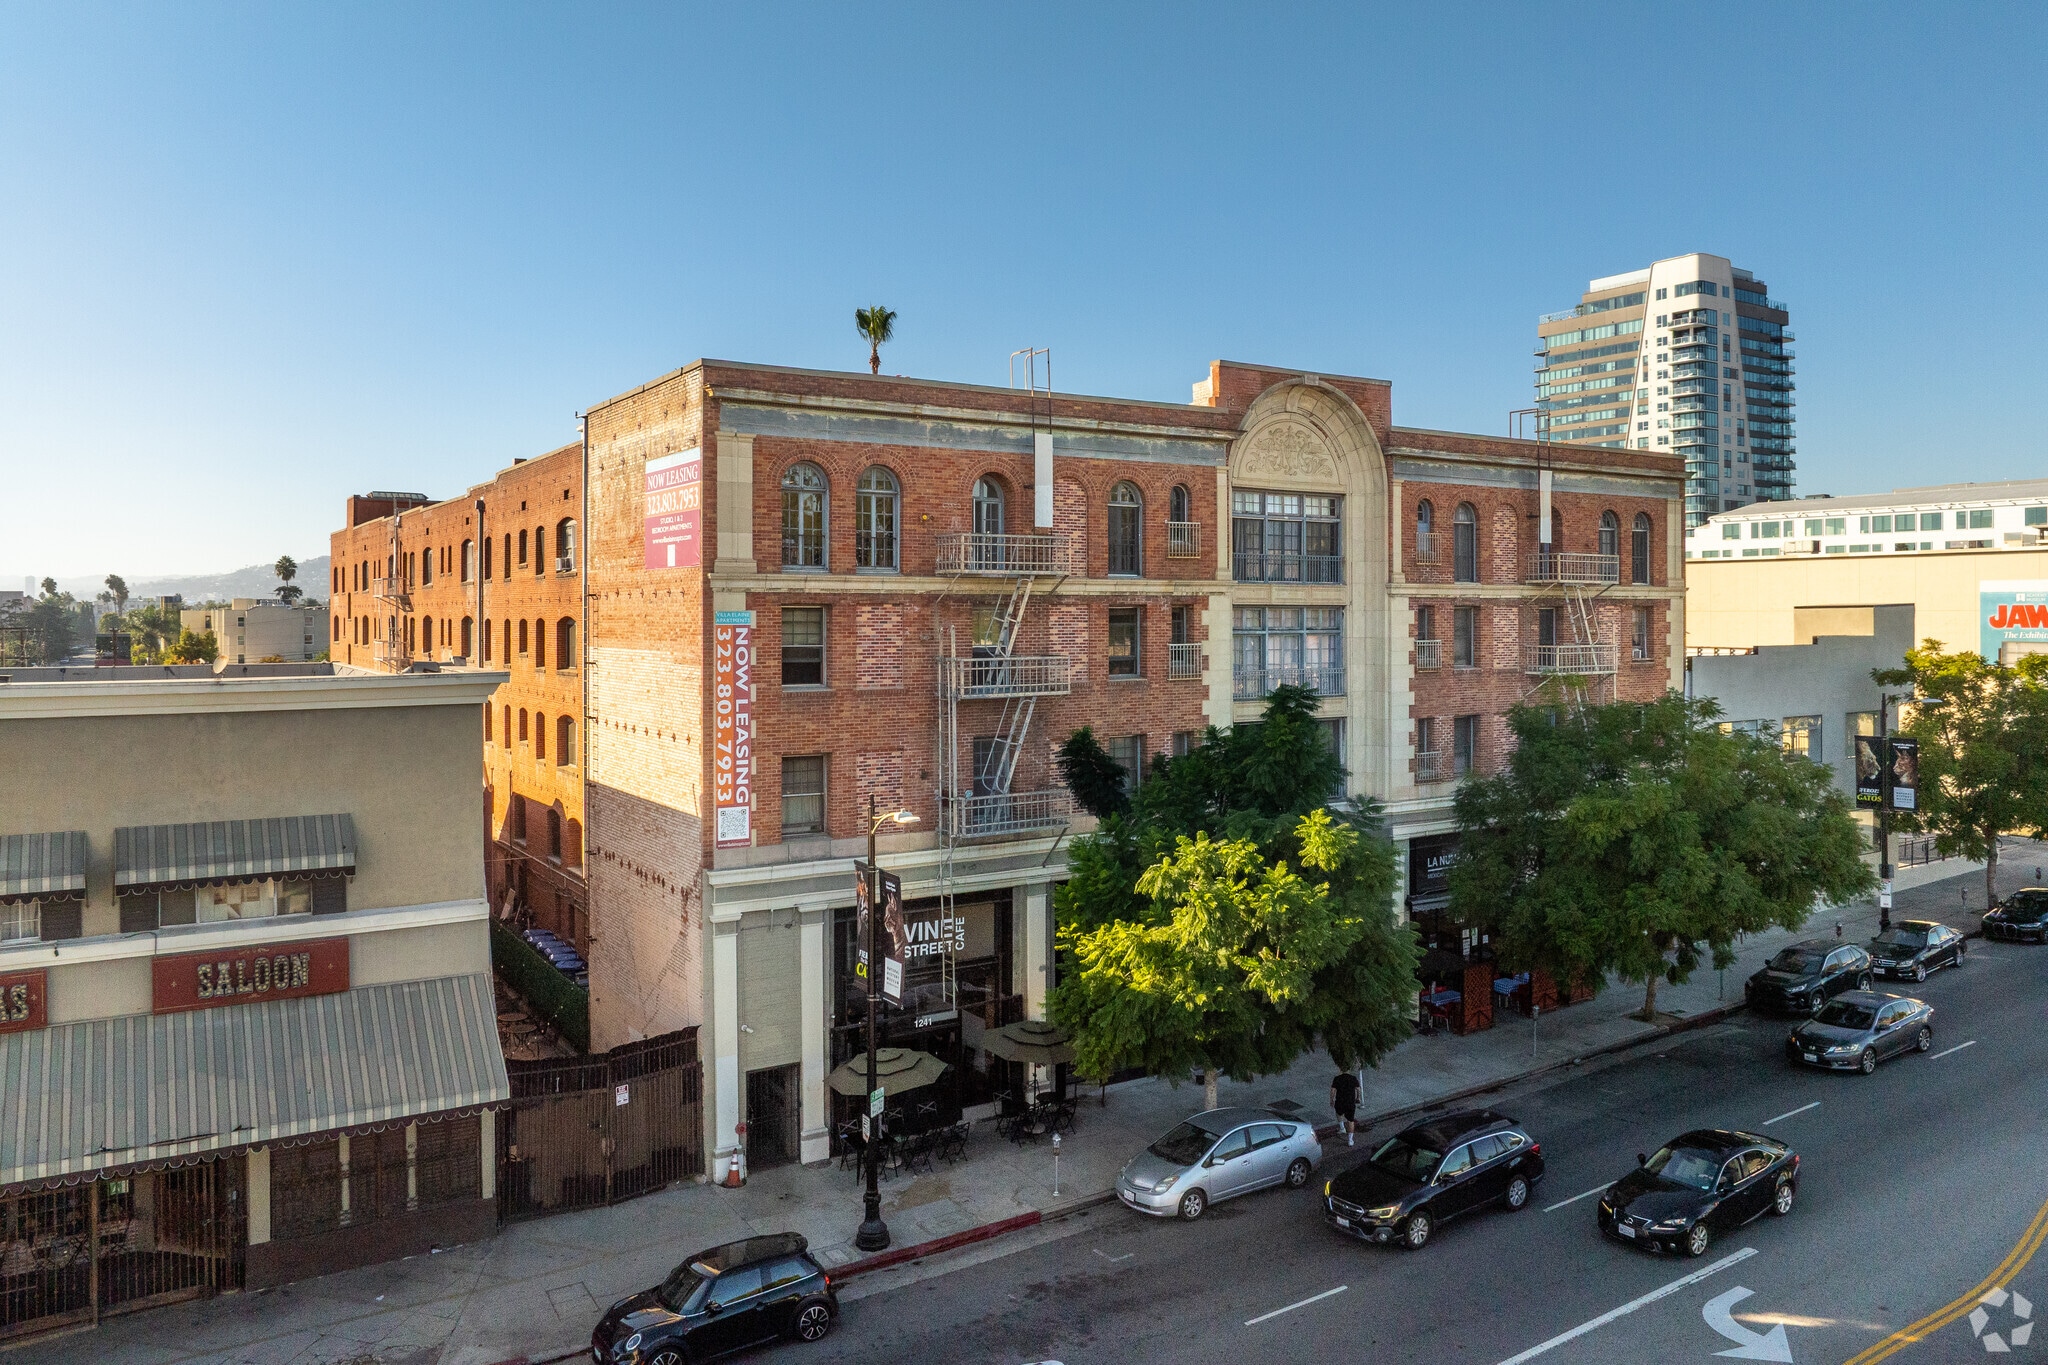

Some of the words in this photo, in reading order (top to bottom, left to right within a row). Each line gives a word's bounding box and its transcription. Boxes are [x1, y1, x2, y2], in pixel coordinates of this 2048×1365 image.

[647, 473, 665, 490] NOW
[666, 464, 698, 486] LEASING
[647, 486, 699, 516] 323.803.7953
[669, 522, 693, 532] APARTMENTS
[2003, 631, 2018, 639] The
[735, 627, 749, 692] NOW
[717, 628, 732, 802] 323.803.7953
[735, 699, 749, 804] LEASING
[1857, 794, 1882, 802] GATOS
[1427, 857, 1438, 867] LA
[903, 918, 953, 943] VINE
[955, 916, 965, 951] CAFE
[904, 940, 953, 959] STREET
[198, 953, 310, 998] SALOON
[914, 1018, 933, 1029] 1241
